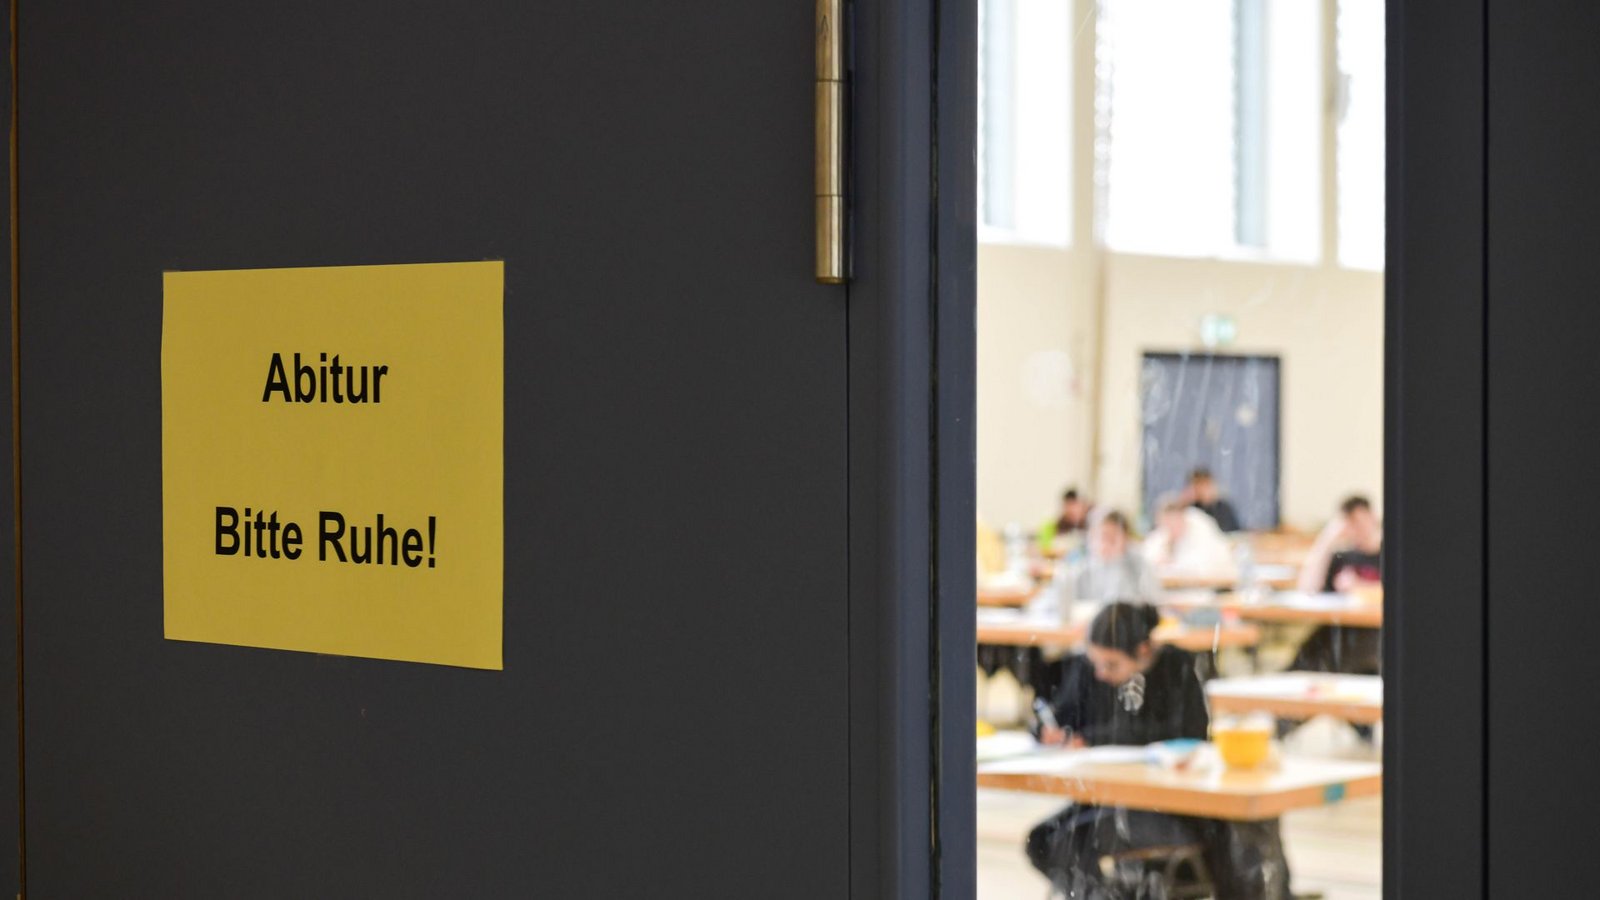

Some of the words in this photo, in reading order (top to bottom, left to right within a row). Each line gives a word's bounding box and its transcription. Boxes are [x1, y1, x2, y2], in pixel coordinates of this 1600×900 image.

[262, 352, 389, 404] Abitur
[215, 506, 303, 561] Bitte
[318, 511, 437, 569] Ruhe!
